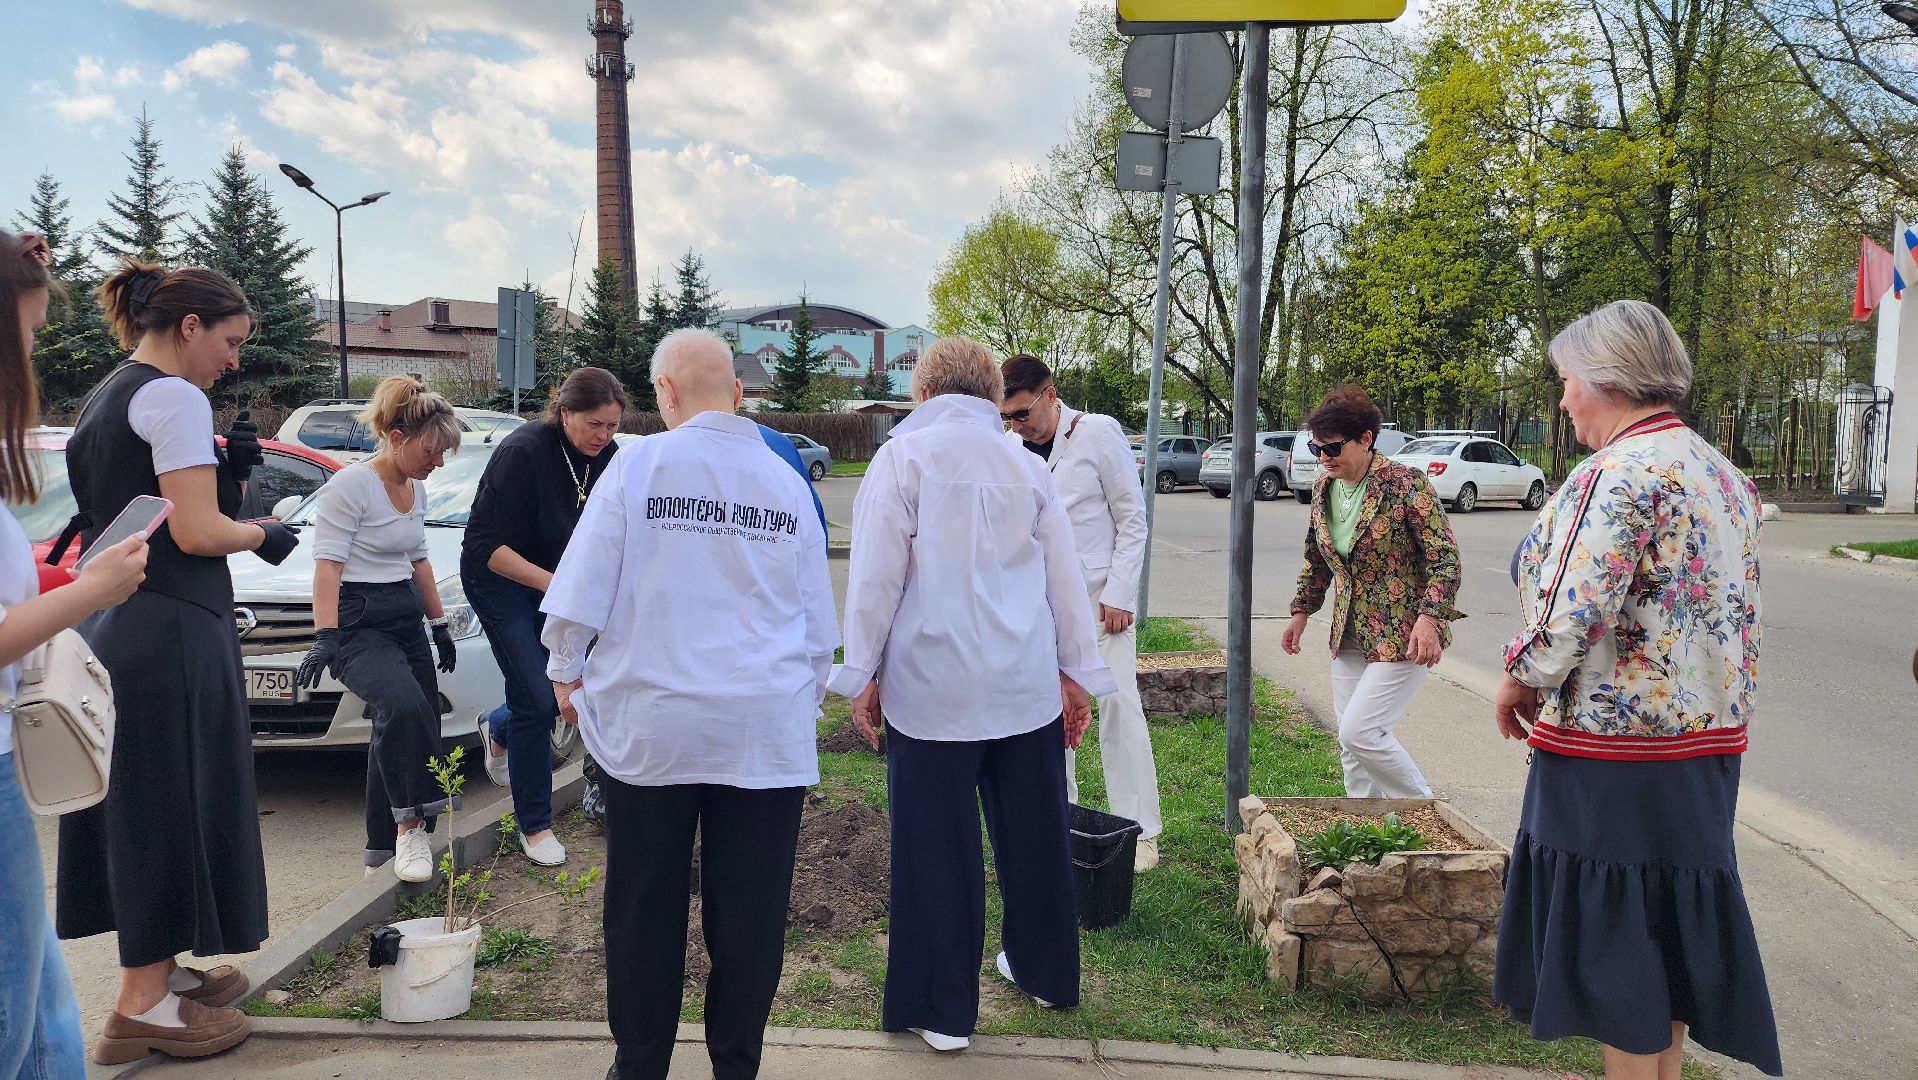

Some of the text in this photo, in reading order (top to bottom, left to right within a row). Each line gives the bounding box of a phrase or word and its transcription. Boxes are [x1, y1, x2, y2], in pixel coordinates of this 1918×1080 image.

[646, 495, 798, 535] ВОЛОНТЁРЫ КУЛЬТУРЫ
[255, 672, 289, 690] 750
